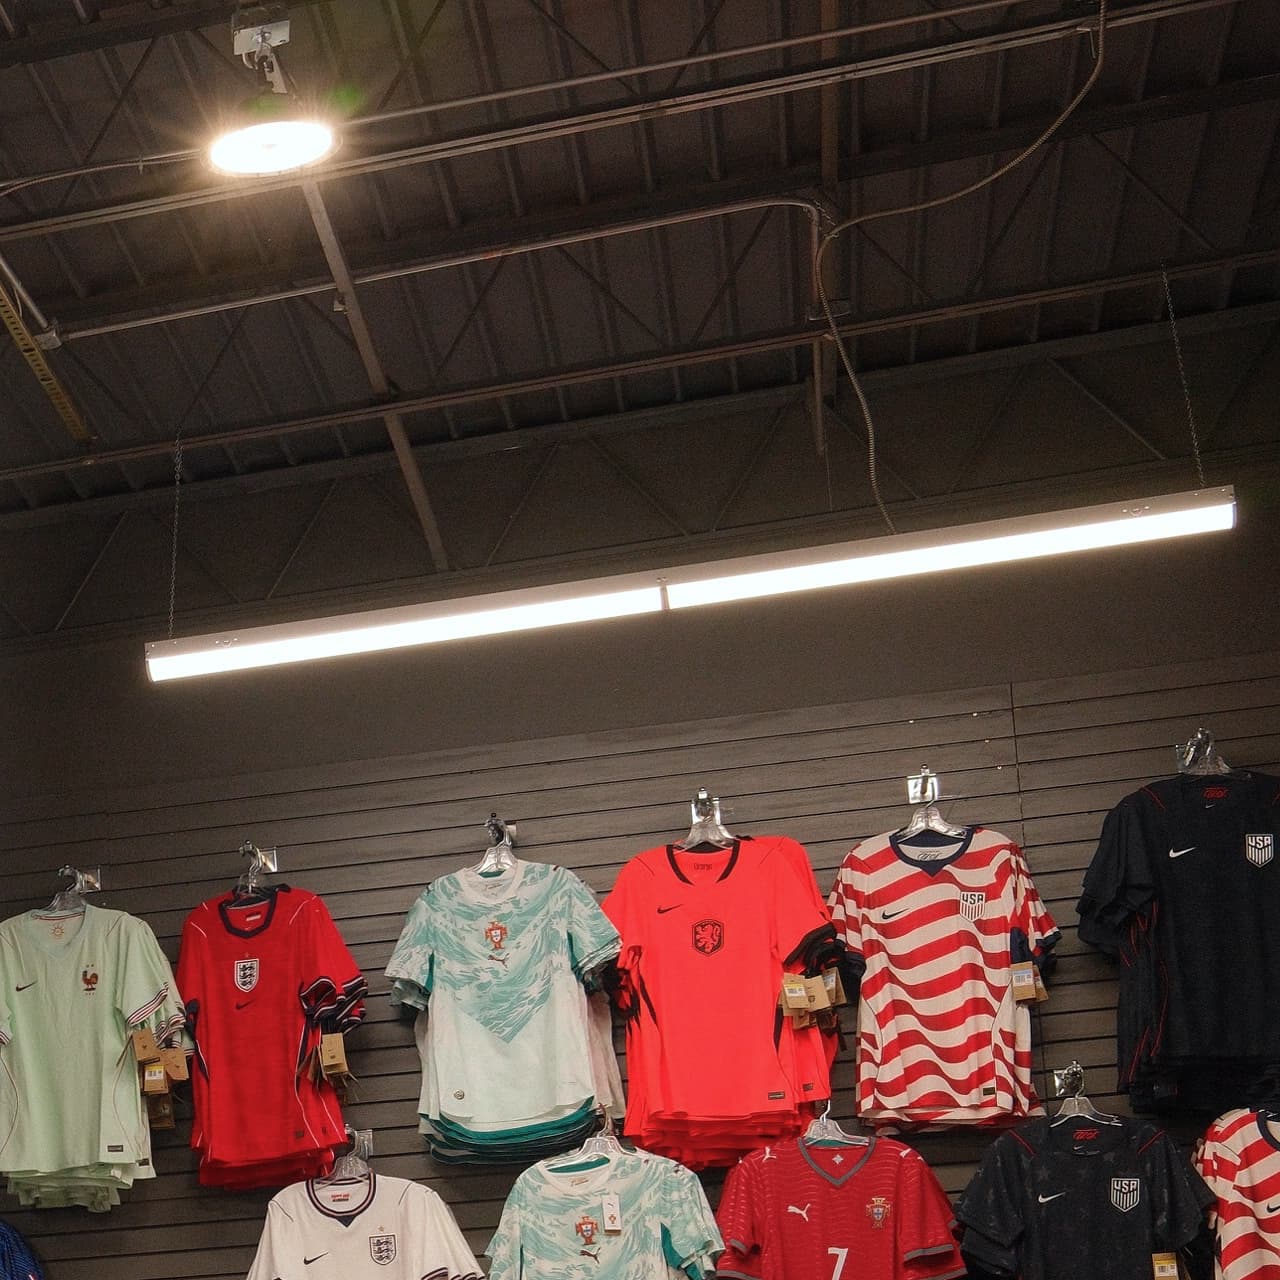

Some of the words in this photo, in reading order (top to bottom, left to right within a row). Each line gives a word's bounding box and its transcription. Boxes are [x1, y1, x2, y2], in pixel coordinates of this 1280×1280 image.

[1248, 836, 1271, 849] USA
[962, 893, 984, 905] USA
[1113, 1180, 1138, 1193] USA
